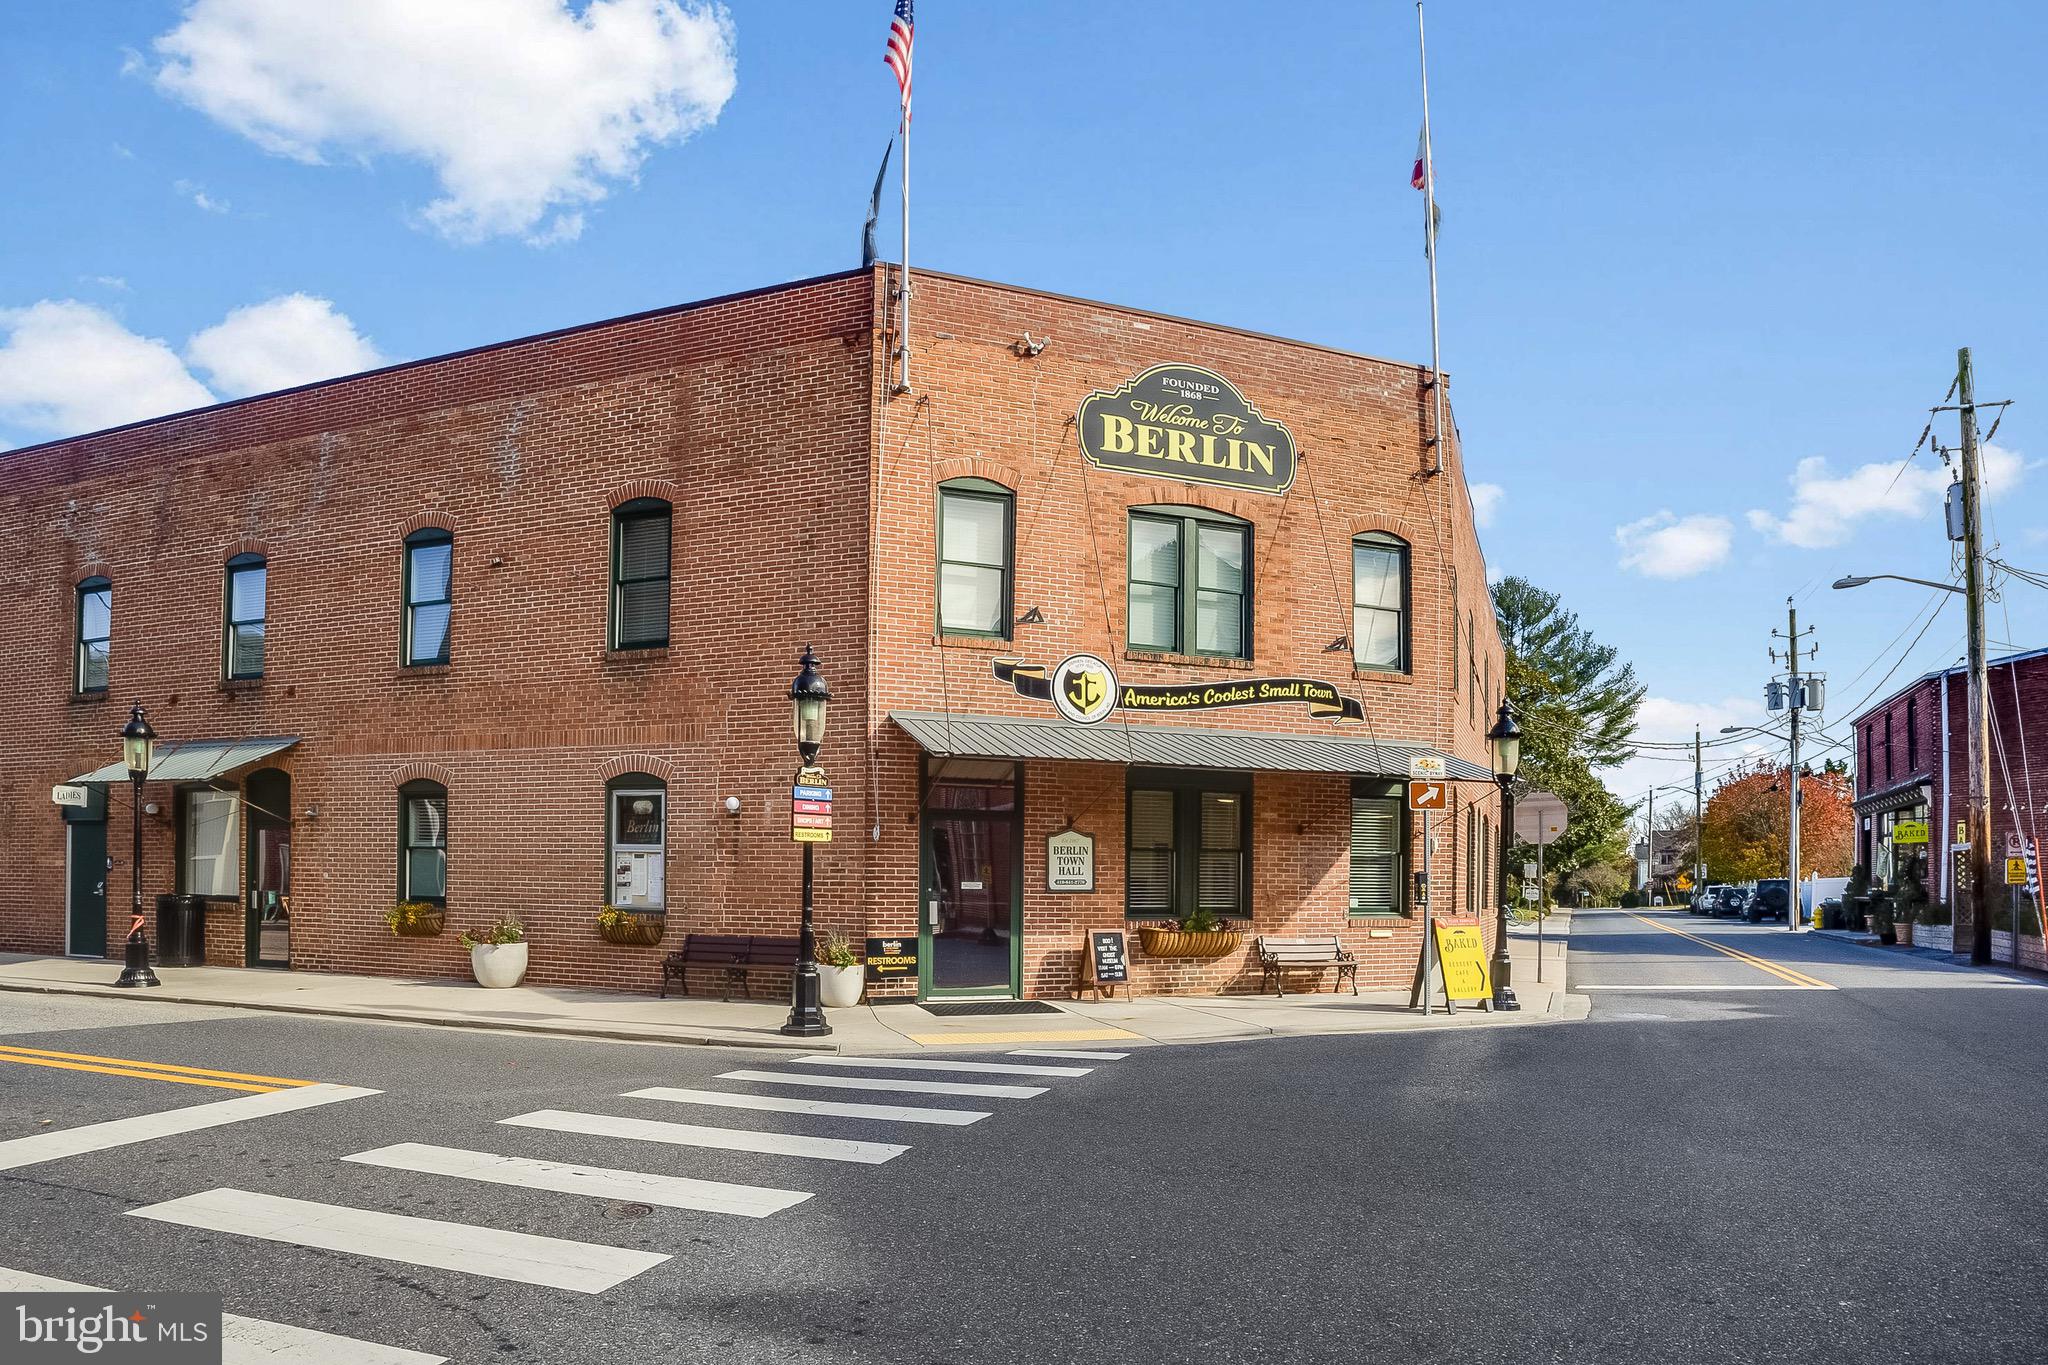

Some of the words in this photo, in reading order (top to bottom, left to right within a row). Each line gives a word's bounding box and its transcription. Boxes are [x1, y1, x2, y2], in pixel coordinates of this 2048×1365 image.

[1162, 377, 1220, 394] FOUNDED
[1180, 390, 1203, 401] 1868
[1130, 400, 1209, 430] Welcome
[1213, 414, 1248, 435] To
[1100, 413, 1276, 476] BERLIN
[1124, 687, 1200, 707] America's
[1203, 685, 1255, 704] Coolest
[1258, 683, 1301, 700] Small
[1303, 683, 1335, 700] Town
[799, 776, 827, 786] BERLIN
[57, 791, 82, 800] LADIES
[799, 789, 822, 798] PARKING
[802, 803, 820, 811] DINING
[626, 819, 659, 833] Berlin
[795, 831, 825, 839] RESTROOMS
[1895, 829, 1926, 840] BAKED
[1053, 845, 1089, 855] BERLIN
[1056, 856, 1085, 866] TOWN
[1058, 866, 1084, 876] HALL
[882, 940, 902, 948] berlin
[1444, 938, 1478, 953] BAKED
[867, 956, 917, 966] RESTROOMS
[1449, 960, 1473, 968] DESSERT
[1453, 986, 1478, 994] GALLERY
